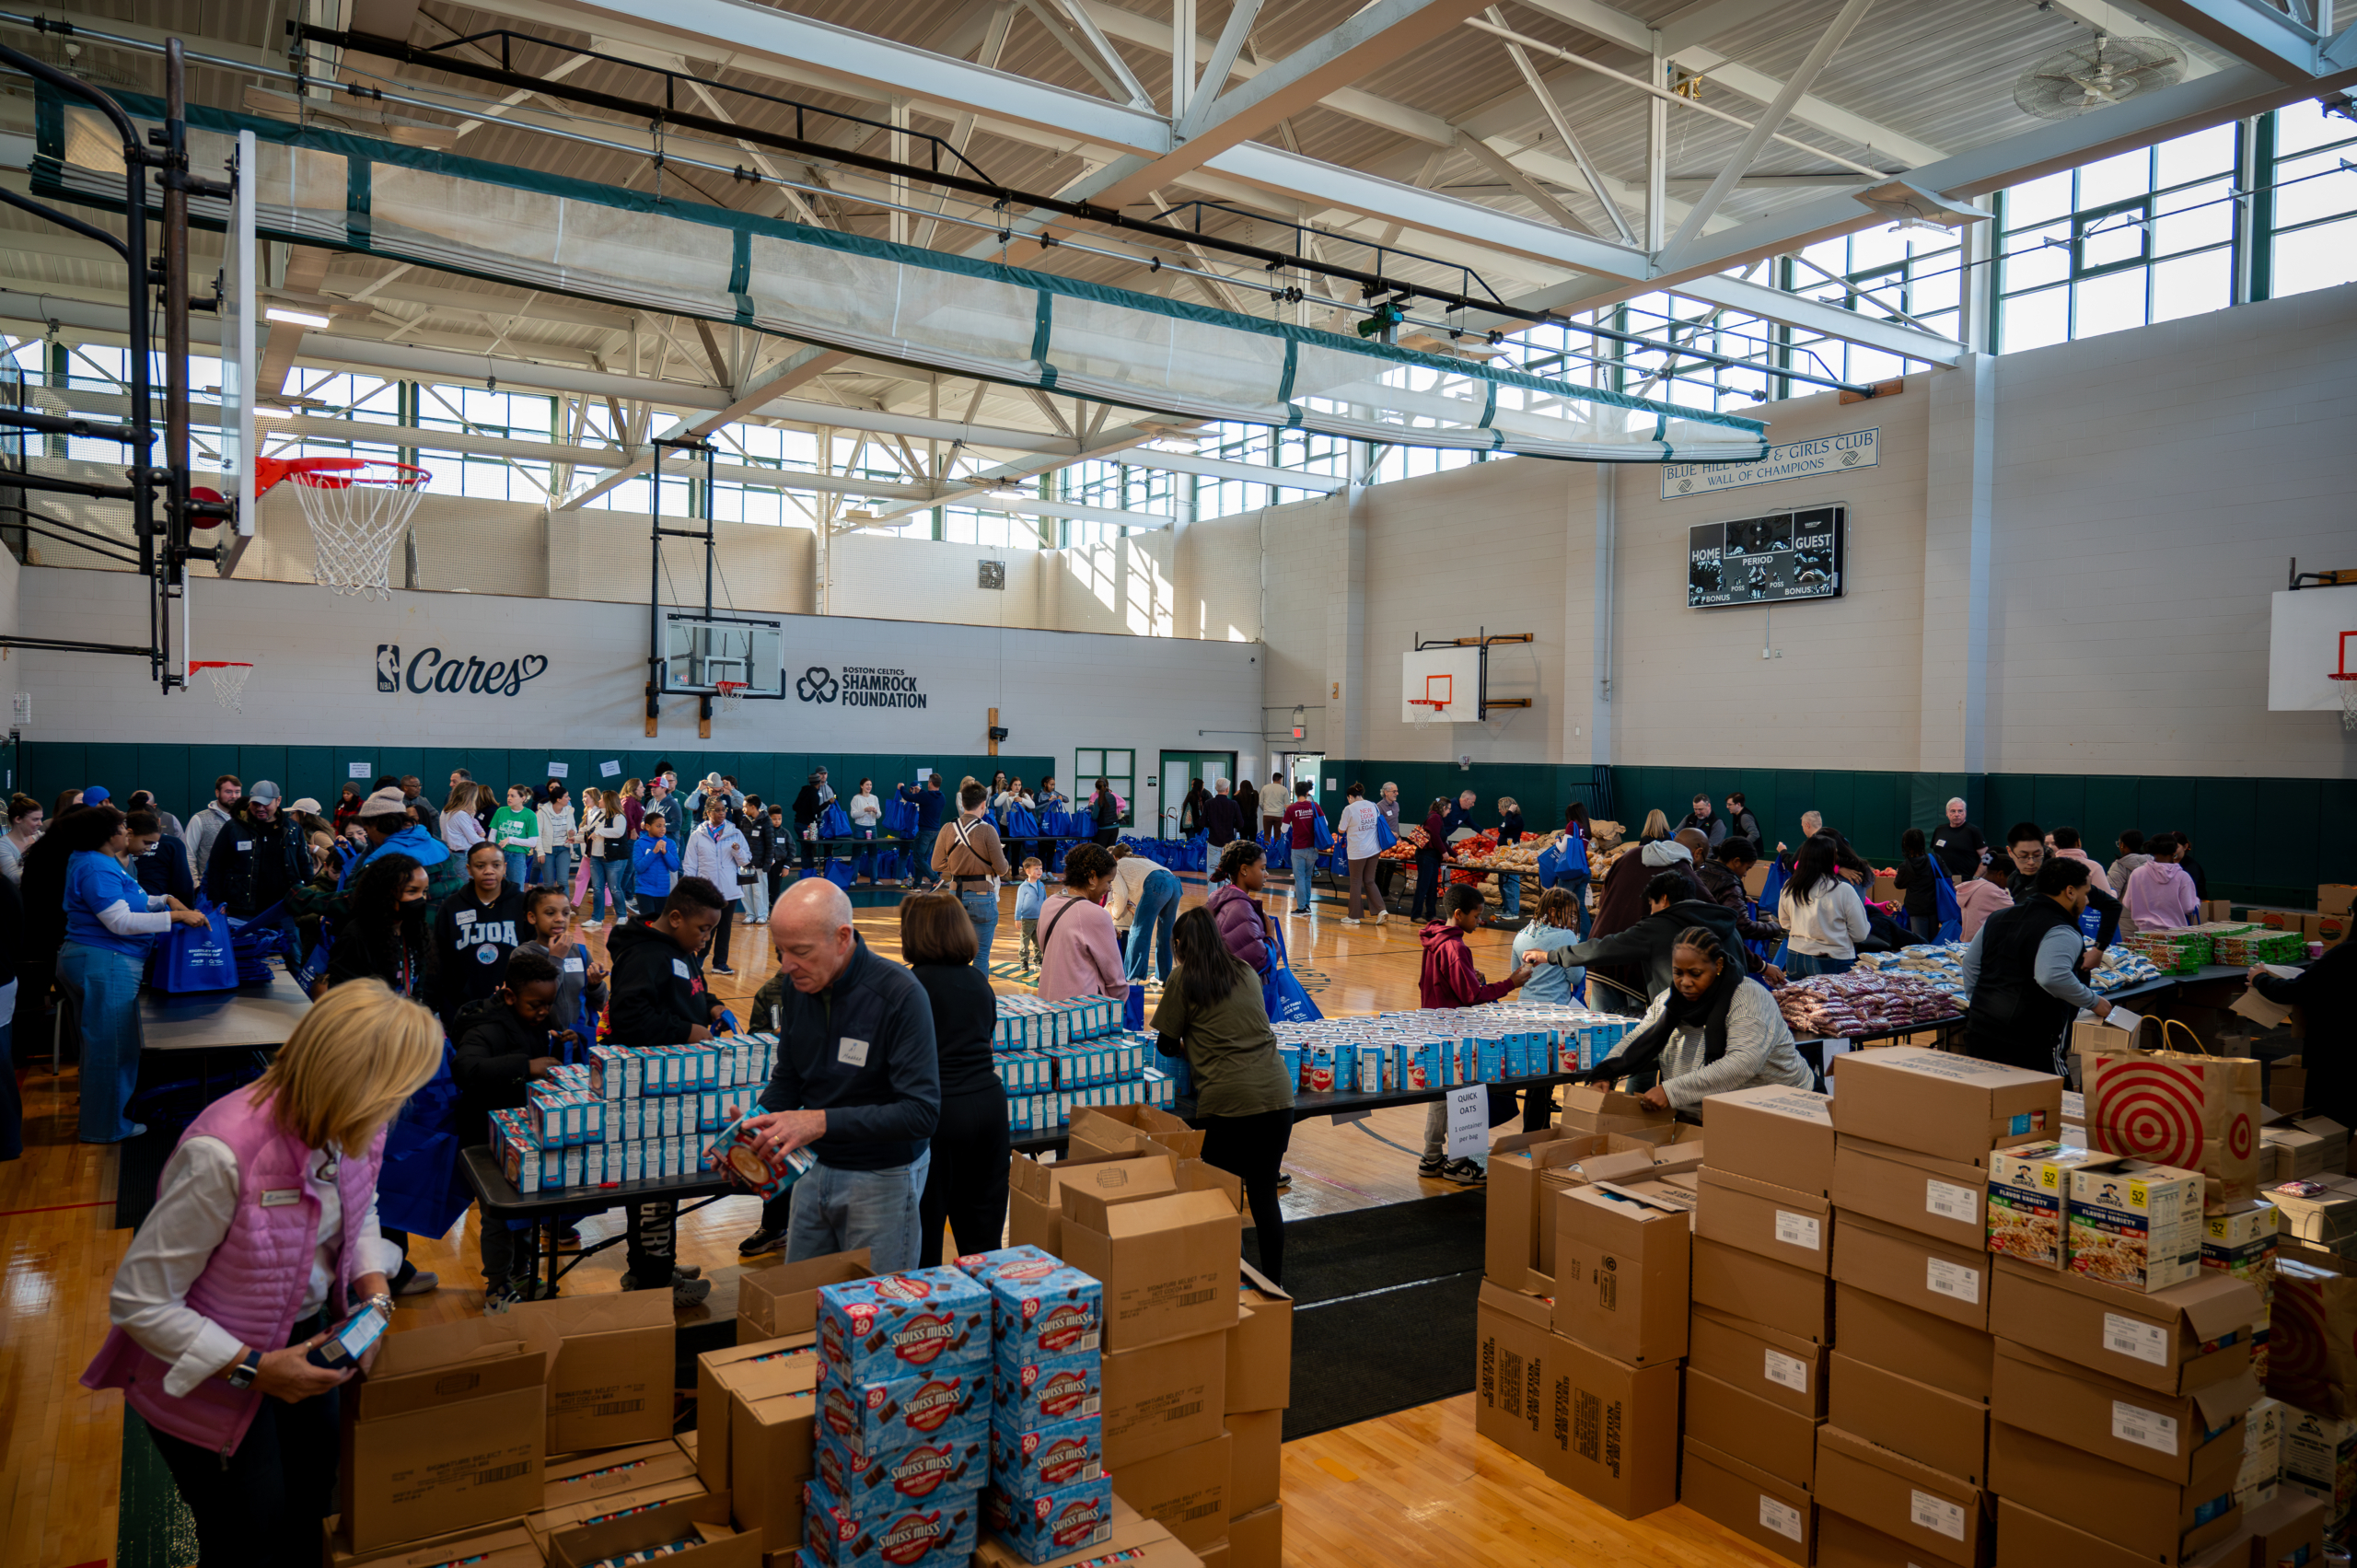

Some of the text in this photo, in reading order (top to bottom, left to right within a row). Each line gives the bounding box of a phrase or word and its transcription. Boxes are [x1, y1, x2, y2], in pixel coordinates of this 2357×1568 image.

[1774, 433, 1874, 460] & GIRLS CLUB
[1666, 465, 1697, 480] BLUE
[1708, 473, 1735, 486] WALL
[1738, 470, 1753, 482] OF
[1757, 459, 1825, 478] CHAMPIONS
[1795, 534, 1832, 550] GUEST
[1691, 547, 1721, 562] HOME
[1742, 556, 1773, 566] PERIOD
[1784, 586, 1812, 596] BONUS
[1705, 594, 1731, 603] BONUS
[405, 647, 525, 697] Cares
[379, 681, 392, 691] NBA
[842, 674, 917, 692] SHAMROCK
[842, 691, 927, 709] FOUNDATION
[456, 921, 518, 950] JJOA
[1457, 1092, 1478, 1103] QUICK
[1459, 1105, 1477, 1115] OATS
[1458, 1121, 1482, 1132] container
[1458, 1135, 1469, 1144] per
[2044, 1171, 2055, 1184] 52
[2012, 1179, 2037, 1190] QUAKER
[1999, 1190, 2048, 1206] FLAVOR VARIETY
[2131, 1190, 2144, 1202] 52
[2096, 1197, 2124, 1208] QUAKER
[2082, 1208, 2136, 1226] FLAVOR VARIETY
[2212, 1221, 2224, 1234] 52
[1147, 1275, 1198, 1293] SIGNATURE SELECT
[1024, 1303, 1037, 1314] 50
[855, 1319, 870, 1331] 50
[1022, 1368, 1037, 1381] 50
[1489, 1365, 1494, 1375] UP
[869, 1392, 883, 1403] 50
[1534, 1387, 1539, 1398] UP
[1562, 1405, 1569, 1416] UP
[1023, 1436, 1037, 1450] 50
[1614, 1431, 1620, 1443] UP
[1037, 1501, 1051, 1515] 50
[840, 1525, 855, 1538] 50
